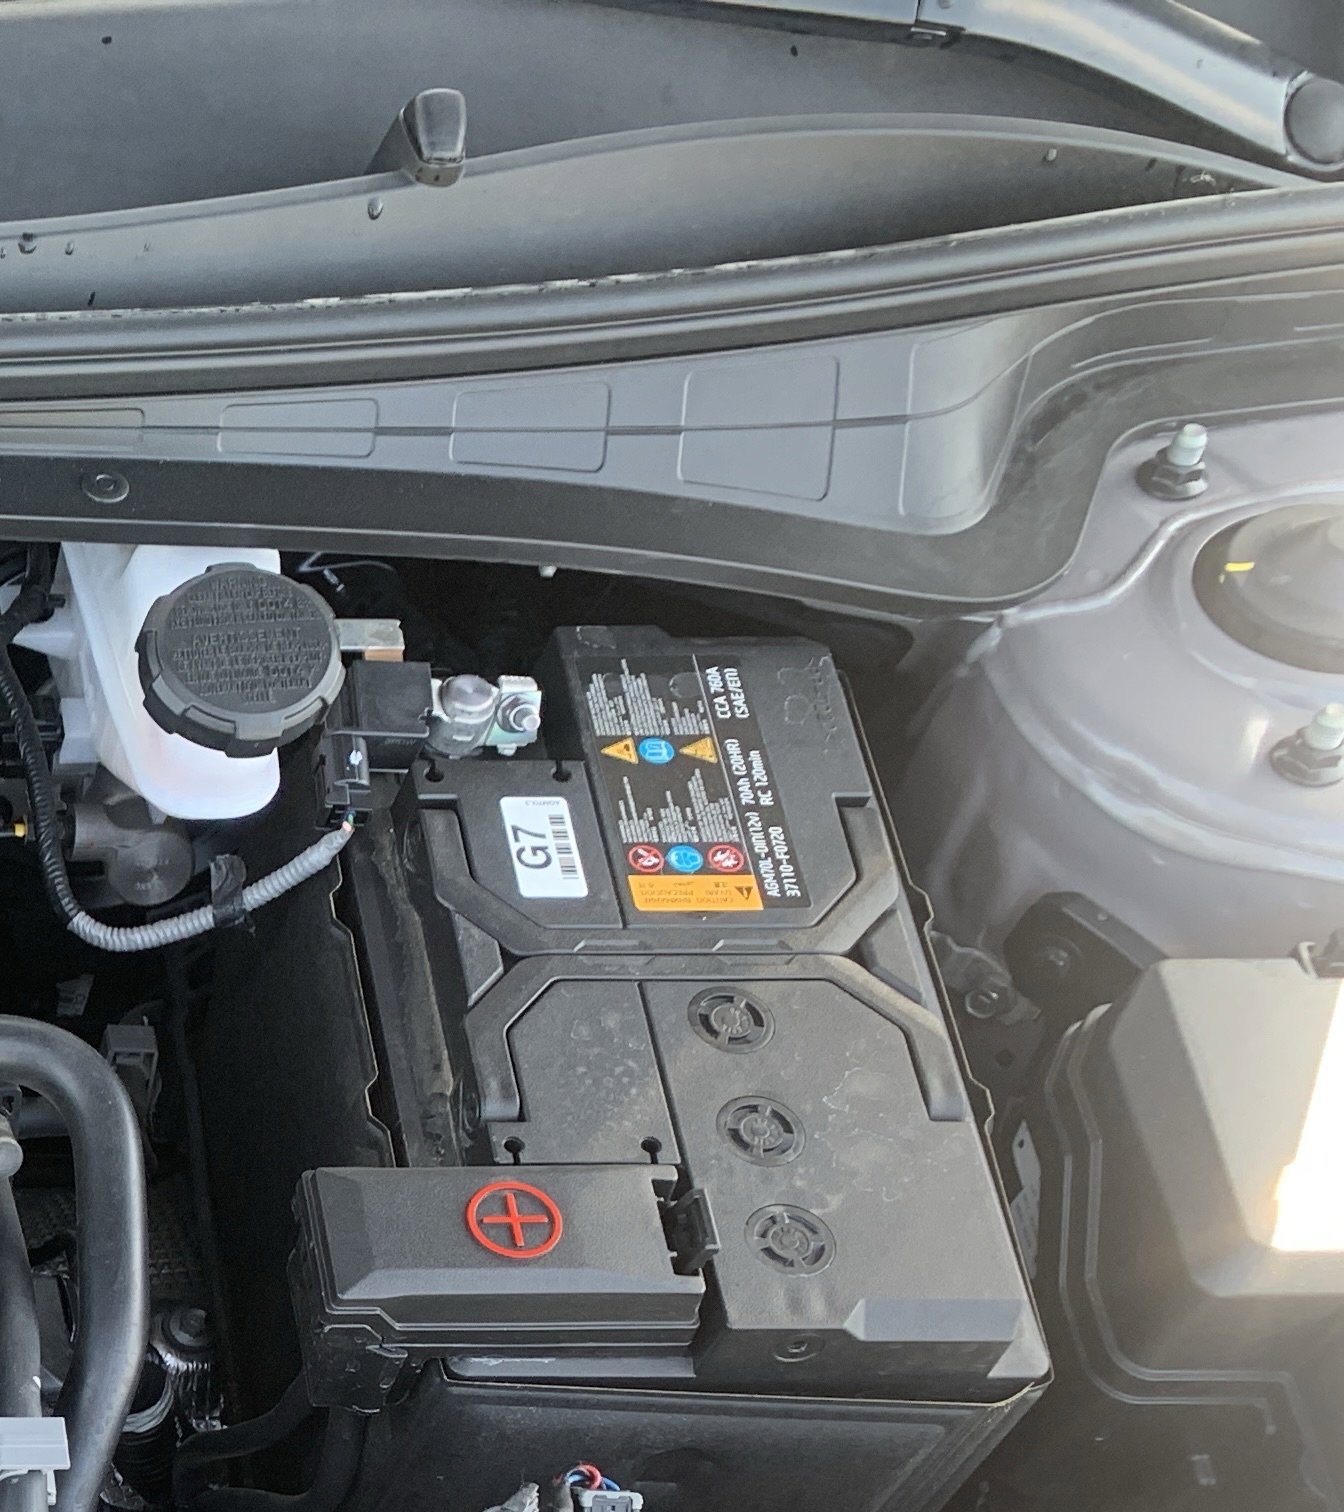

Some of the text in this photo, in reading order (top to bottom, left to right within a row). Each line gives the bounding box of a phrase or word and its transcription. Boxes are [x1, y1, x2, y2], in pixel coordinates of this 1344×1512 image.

[706, 665, 733, 720] CCA 760A
[725, 737, 757, 806] 70Ah (20HR)
[748, 750, 774, 806] RC 120min
[507, 825, 550, 870] G7
[770, 826, 802, 898] 37110-F0720
